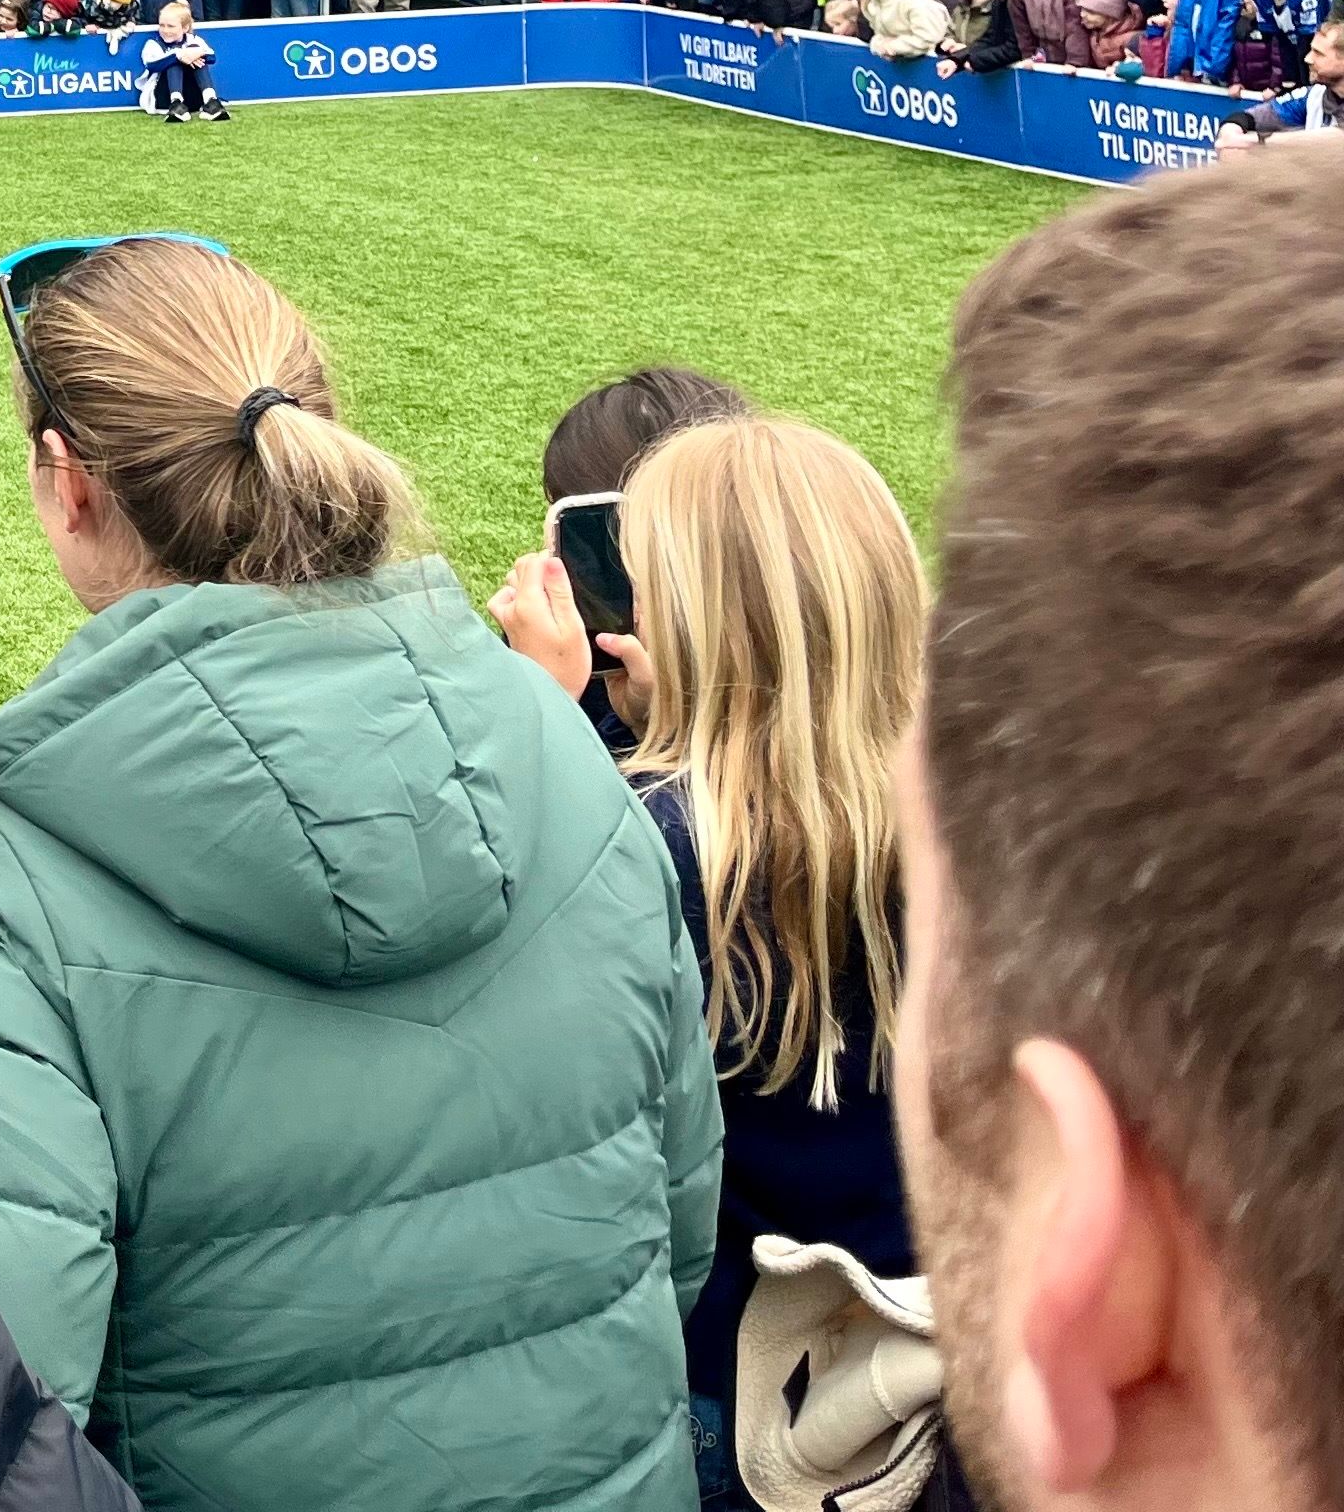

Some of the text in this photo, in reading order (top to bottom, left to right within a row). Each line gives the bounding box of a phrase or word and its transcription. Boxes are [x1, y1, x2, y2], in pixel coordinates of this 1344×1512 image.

[341, 43, 437, 76] OBOS
[680, 33, 758, 67] VI GIR TILBAKE
[38, 70, 132, 95] LIGAEN
[684, 58, 756, 91] TIL IDRETTEN
[890, 84, 958, 128] OBOS
[1088, 99, 1220, 143] VI GIR TILBA
[1098, 131, 1219, 170] TIL IDRETTE
